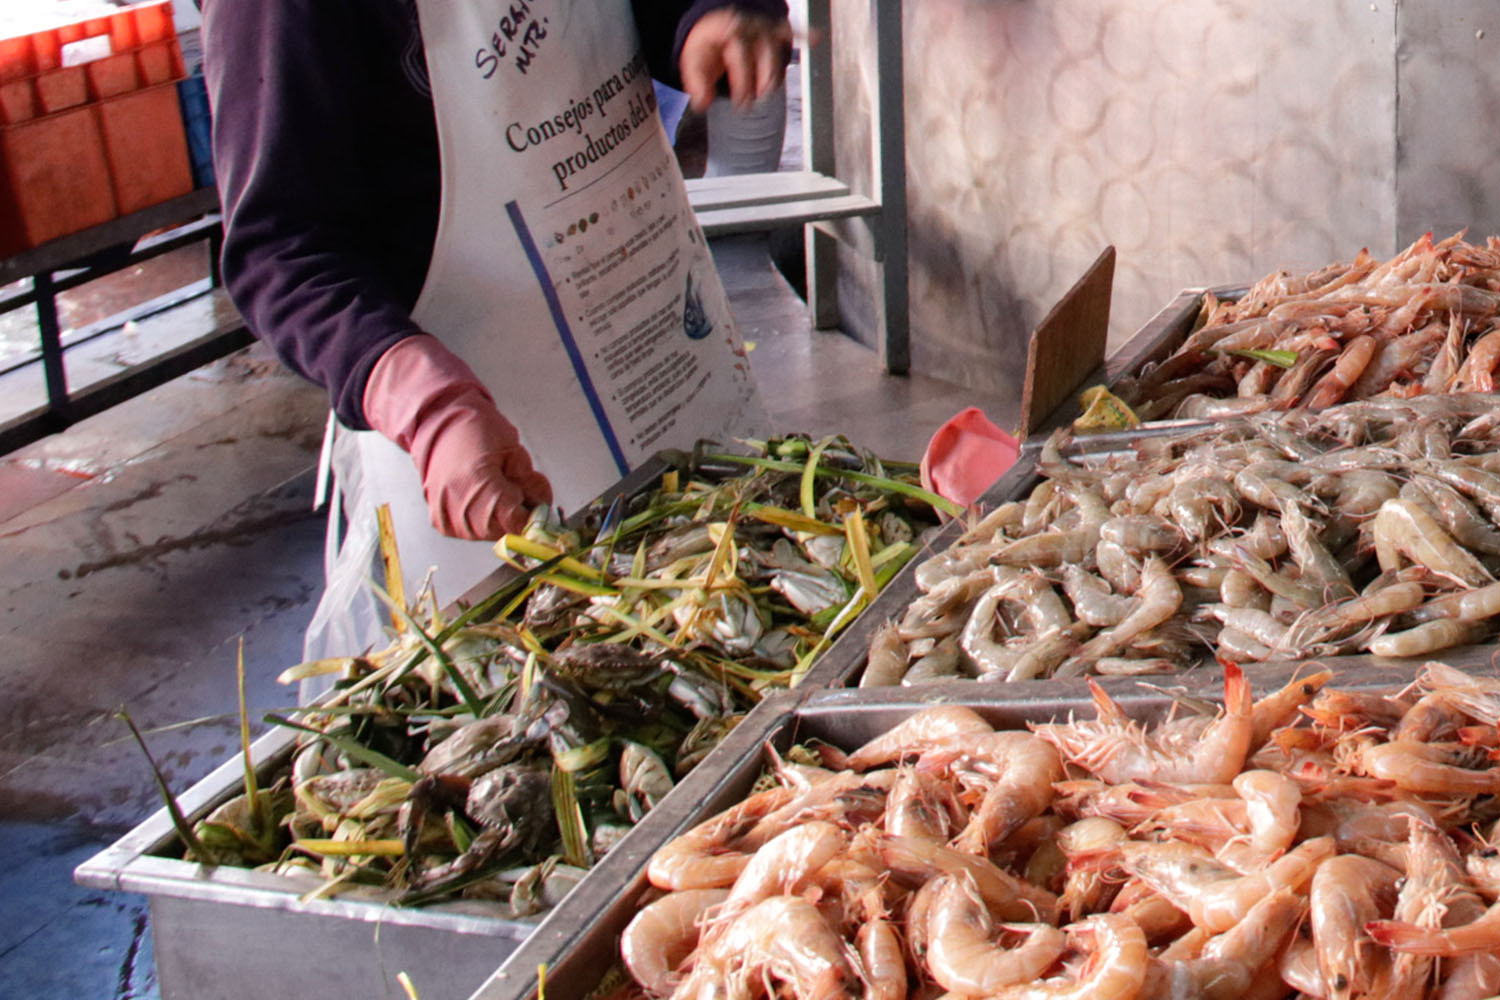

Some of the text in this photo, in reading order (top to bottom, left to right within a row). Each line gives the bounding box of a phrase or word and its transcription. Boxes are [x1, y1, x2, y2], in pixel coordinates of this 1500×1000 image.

[506, 99, 594, 152] Consejos
[592, 74, 625, 118] para
[552, 111, 631, 192] productos
[628, 94, 649, 130] del
